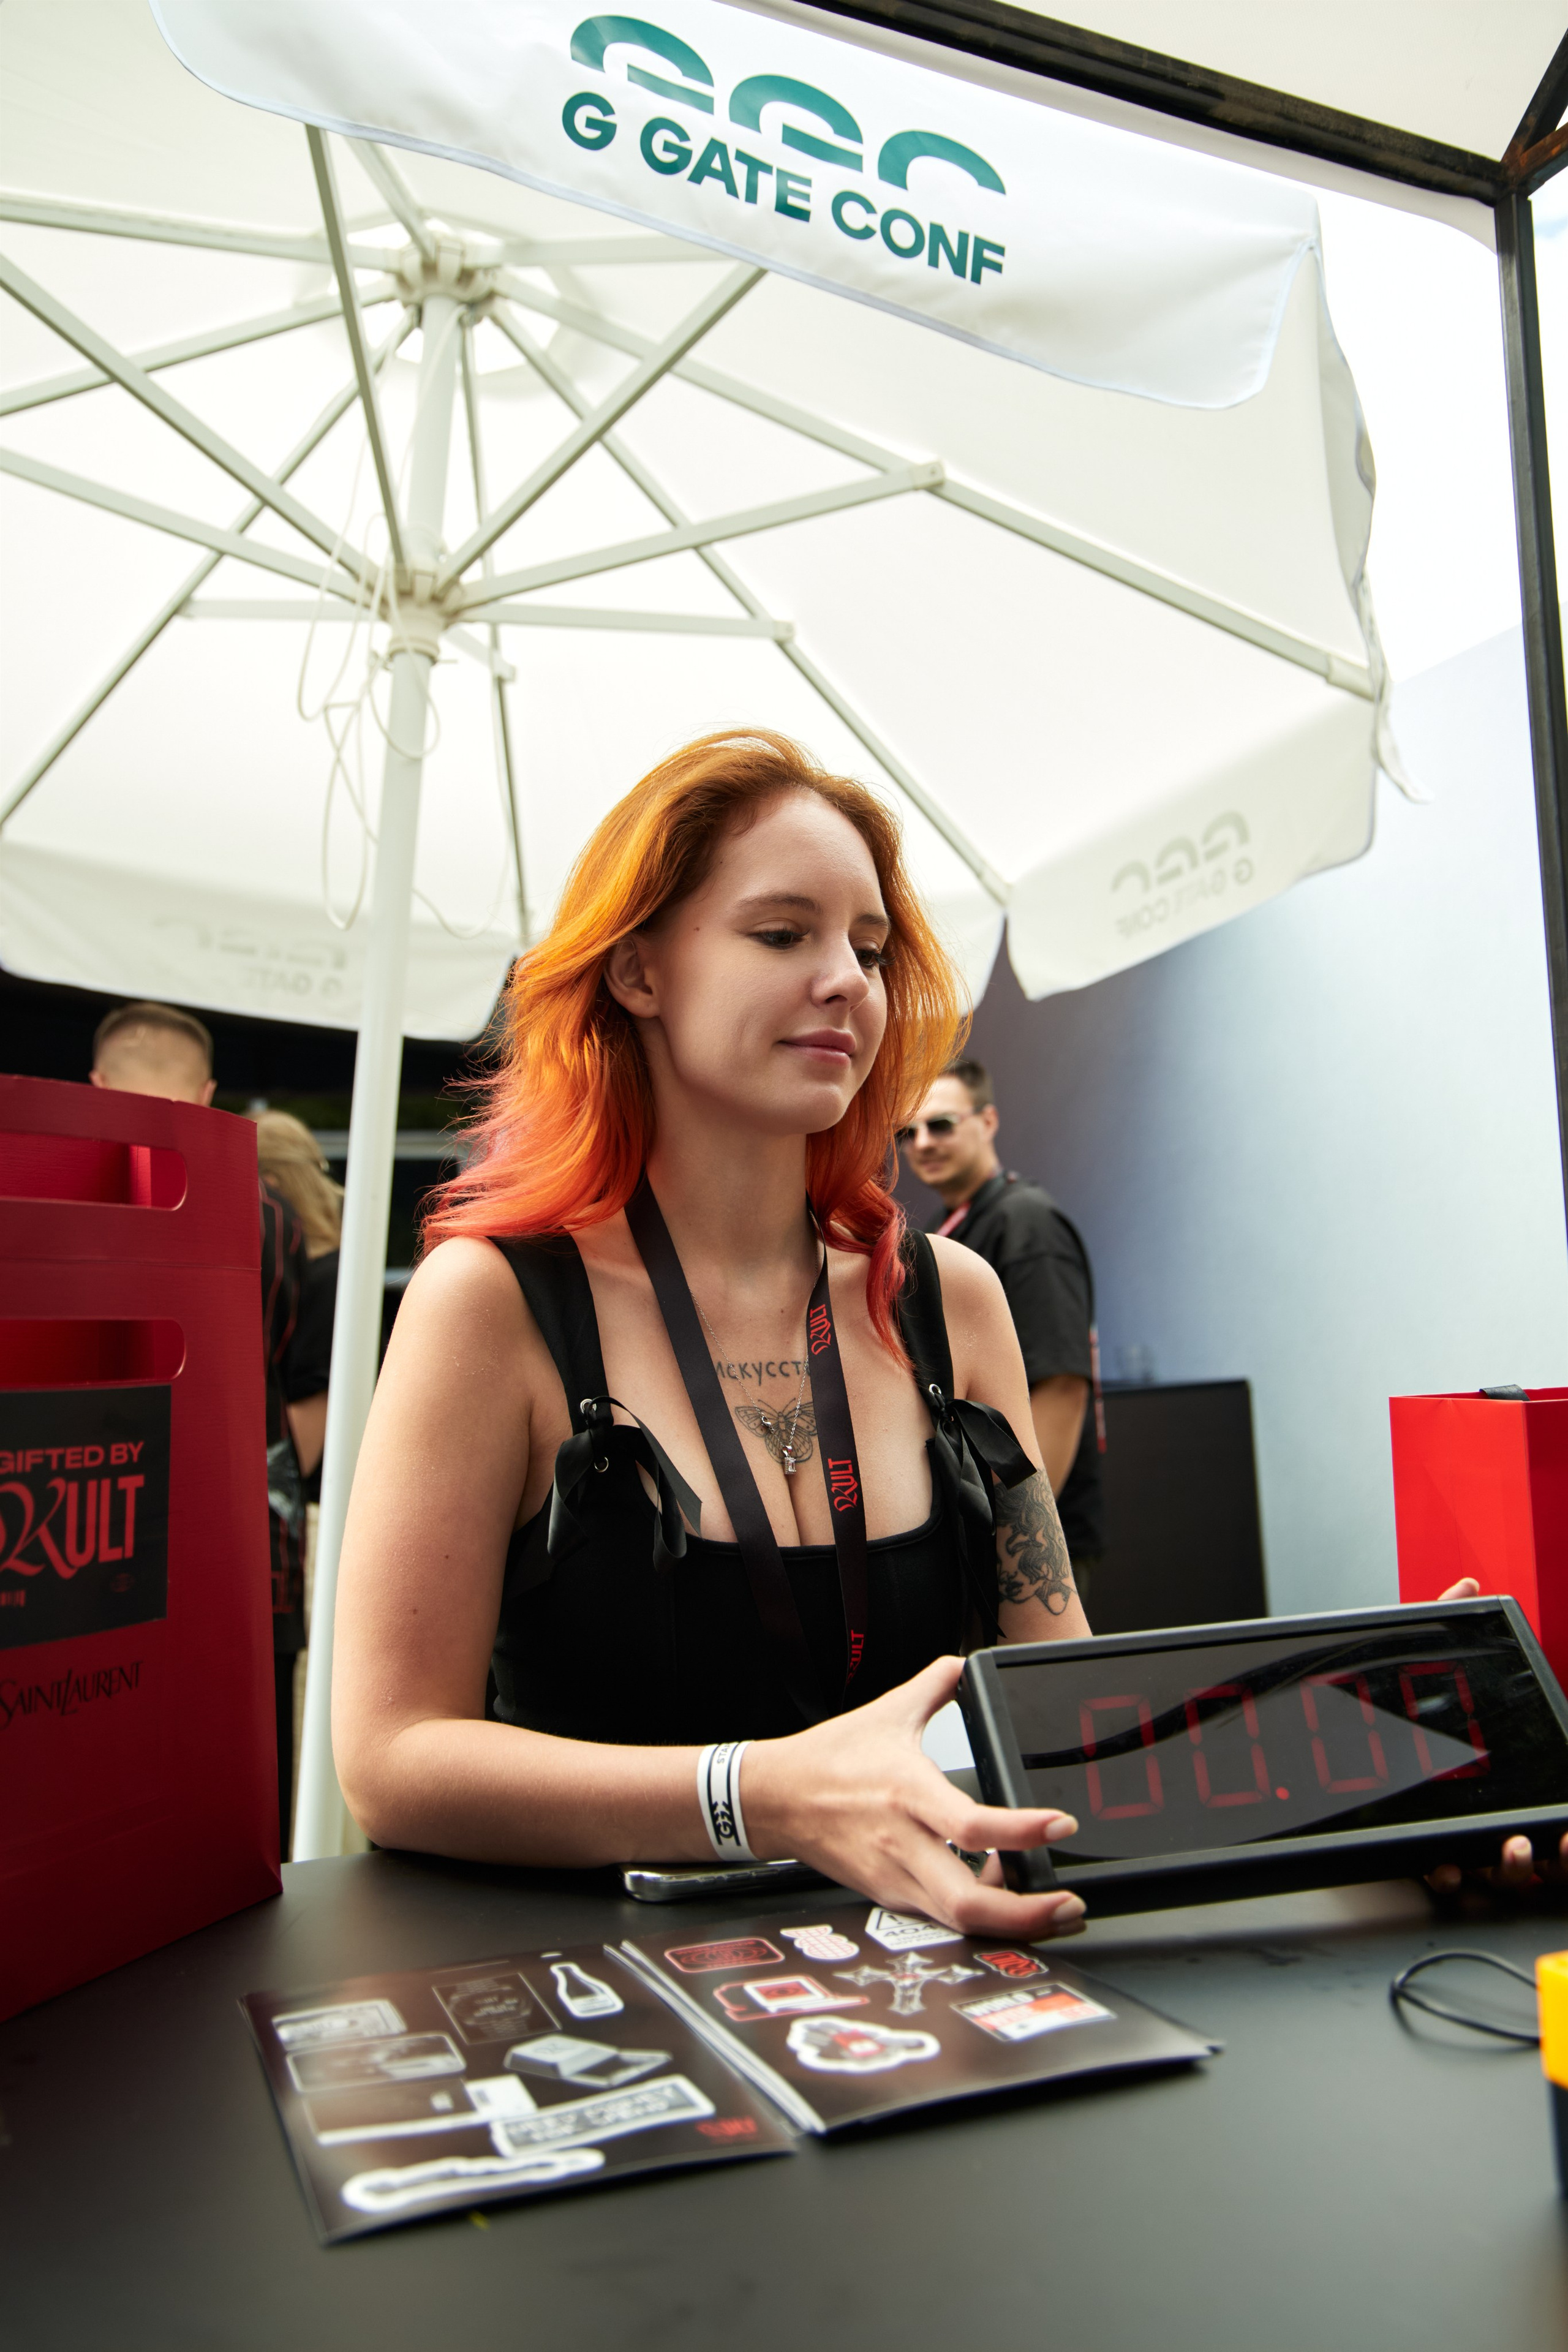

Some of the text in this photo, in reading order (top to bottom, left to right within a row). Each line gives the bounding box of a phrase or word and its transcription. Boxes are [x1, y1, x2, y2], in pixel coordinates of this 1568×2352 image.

[562, 91, 1005, 285] G GATE CONF
[0, 1441, 145, 1474] GIFTED BY
[828, 1458, 858, 1512] KULT
